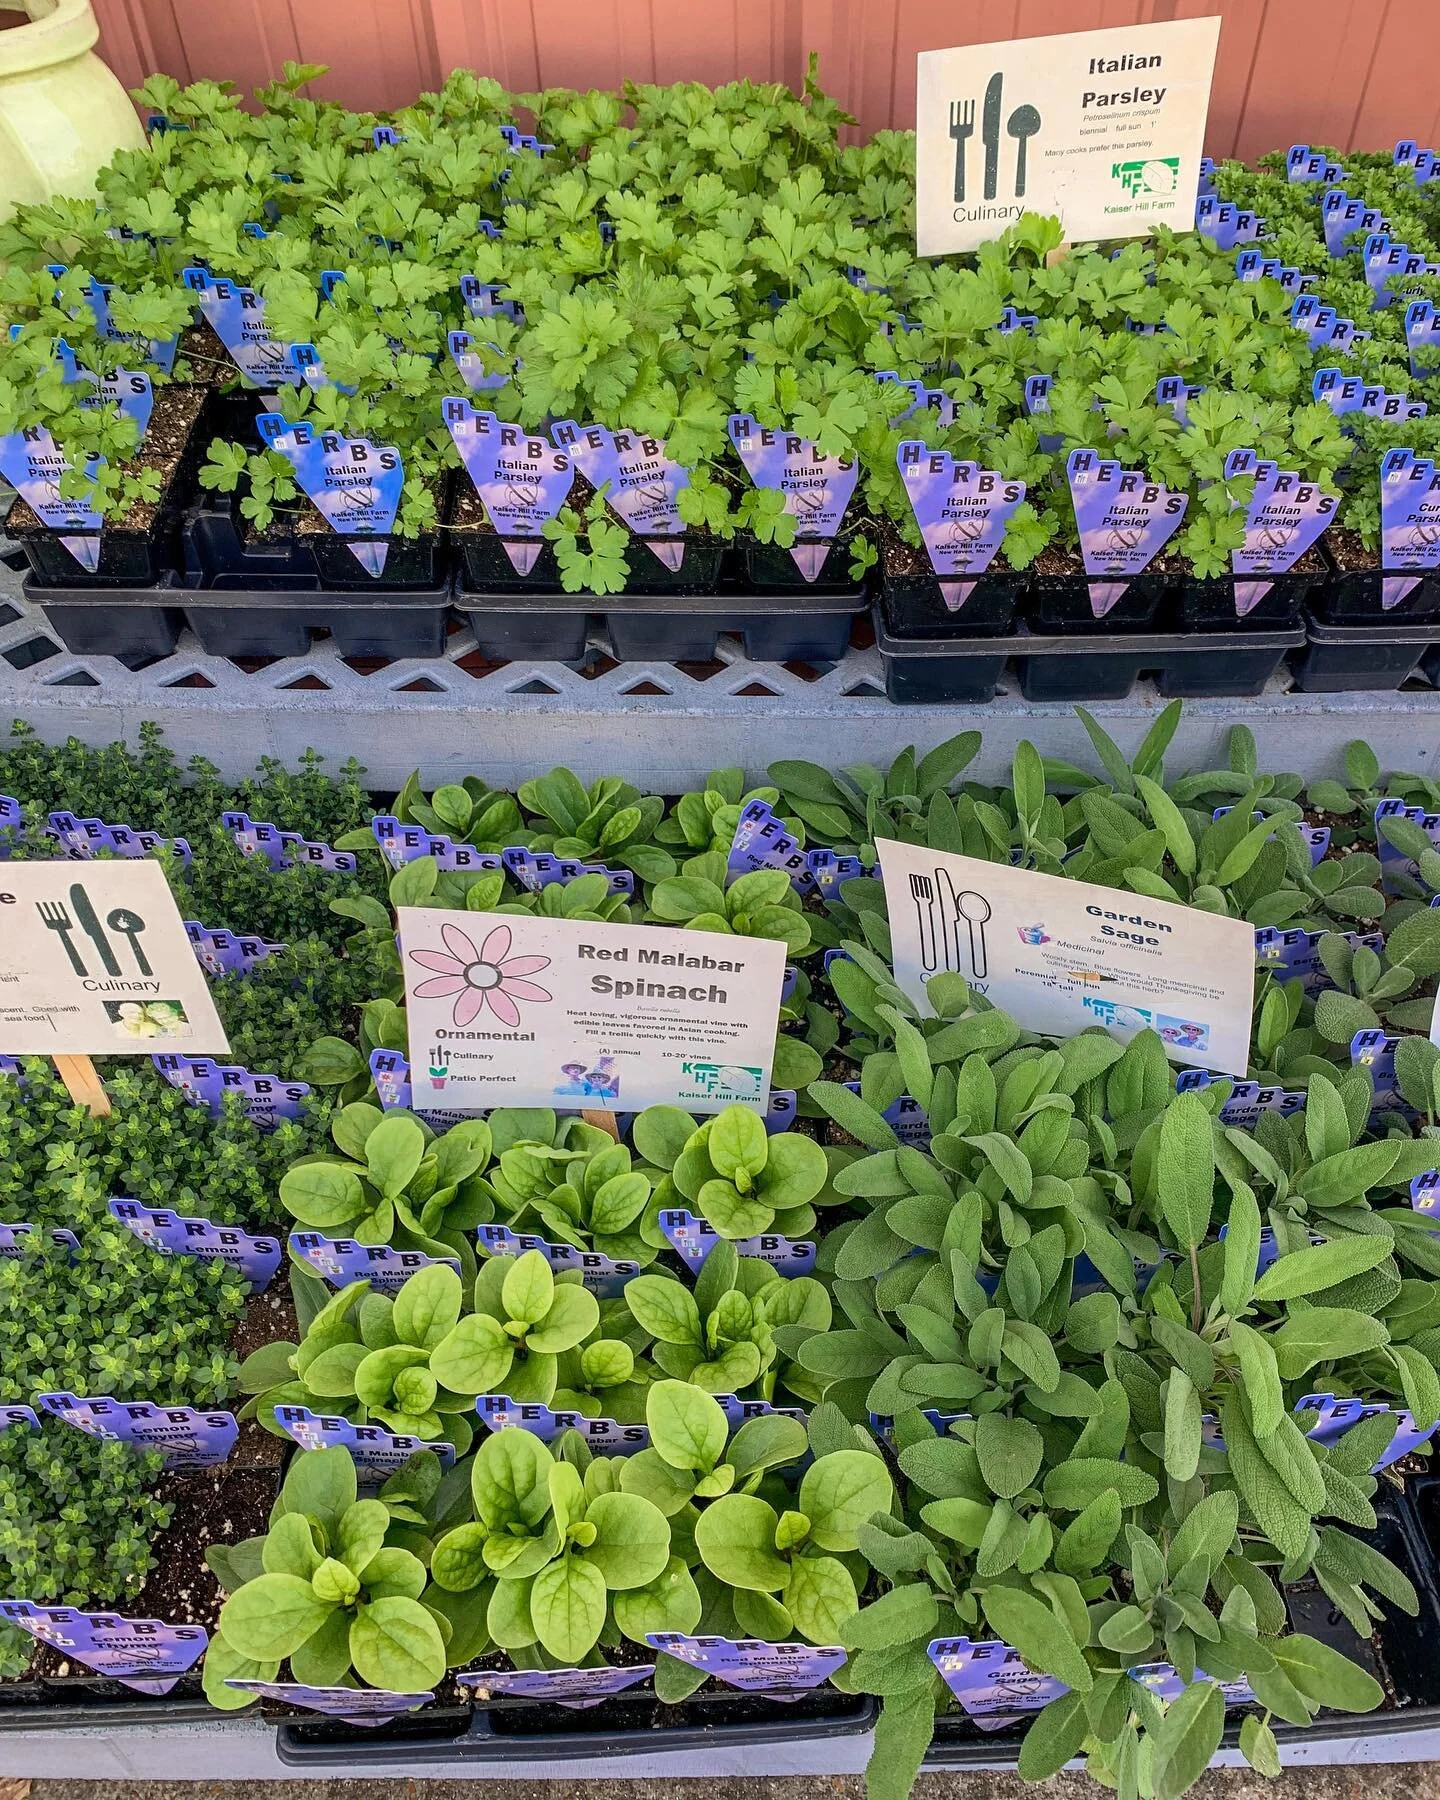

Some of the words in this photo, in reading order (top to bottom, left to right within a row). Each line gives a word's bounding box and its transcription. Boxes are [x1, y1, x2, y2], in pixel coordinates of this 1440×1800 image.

[1089, 53, 1162, 75] Italian
[1082, 87, 1167, 109] Parsley
[1080, 125, 1108, 136] biennial
[1116, 123, 1127, 132] full
[1066, 147, 1087, 155] cooks
[1089, 145, 1111, 153] prefer
[953, 204, 1025, 223] Culinary
[1104, 203, 1132, 214] Kaiser
[1135, 202, 1149, 212] Hill
[1152, 200, 1175, 210] Farm
[263, 419, 396, 470] HERBS
[448, 403, 569, 472] HERBS
[557, 426, 660, 457] HERB
[325, 465, 366, 476] Italian
[497, 459, 538, 472] Italian
[619, 460, 659, 476] Italian
[784, 467, 824, 478] Italian
[325, 477, 373, 488] Parsley
[494, 471, 543, 485] Parsley
[619, 470, 666, 488] Parsley
[903, 445, 1020, 504] HERBS
[781, 478, 829, 490] Parsley
[1073, 453, 1182, 516] HERBS
[1231, 453, 1334, 515] HERBS
[946, 497, 988, 507] Italian
[1261, 505, 1301, 515] Italian
[942, 508, 991, 520] Parsley
[1109, 505, 1149, 516] Italian
[1102, 517, 1151, 528] Parsley
[1253, 517, 1302, 529] Parsley
[746, 805, 815, 885] HERBS
[1086, 905, 1173, 933] Garden
[1100, 925, 1160, 946] Sage
[1057, 940, 1105, 956] Medicinal
[1090, 936, 1118, 947] Salvia
[1120, 943, 1163, 957] officinalis
[578, 944, 628, 962] Red
[638, 949, 745, 973] Malabar
[1015, 967, 1057, 980] Perennial
[1067, 978, 1082, 986] full
[83, 979, 161, 994] Culinary
[591, 974, 728, 1004] Spinach
[660, 1017, 708, 1025] ornamental
[435, 1028, 536, 1042] Ornamental
[453, 1052, 495, 1061] Culinary
[159, 1056, 303, 1102] HERBS
[450, 1075, 477, 1083] Patio
[479, 1075, 517, 1083] Perfect
[678, 1091, 712, 1100] Kaiser
[714, 1093, 733, 1101] Hill
[735, 1095, 761, 1103] Farm
[116, 1204, 274, 1255] HERBS
[186, 1245, 239, 1254] Lemon
[47, 1397, 229, 1429] HERBS
[485, 1396, 645, 1443] HERBS
[131, 1425, 191, 1434] Lemon
[283, 1407, 449, 1457] HERBS
[3, 1605, 200, 1641] HERBS
